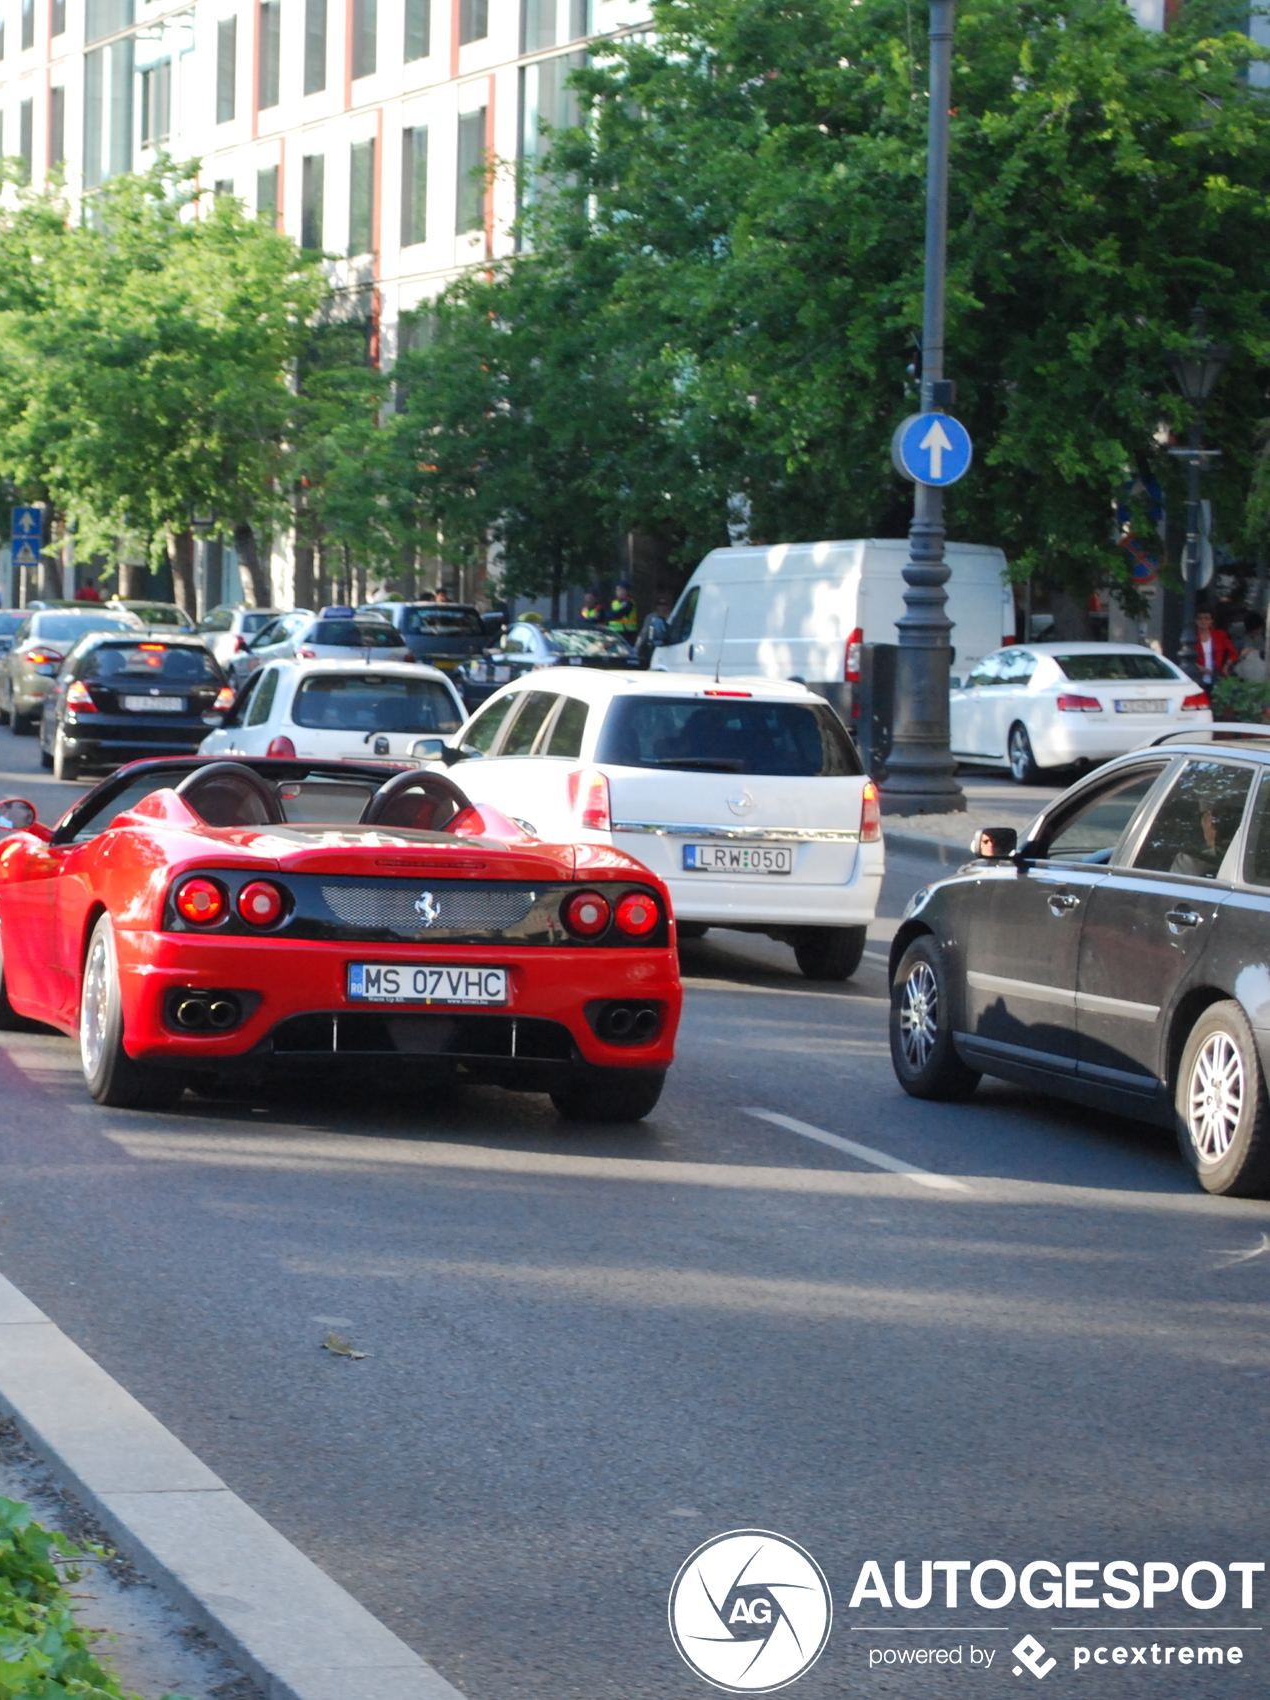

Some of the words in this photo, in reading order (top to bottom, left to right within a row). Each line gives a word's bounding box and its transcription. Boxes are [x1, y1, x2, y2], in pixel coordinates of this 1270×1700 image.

[351, 982, 363, 994] RO
[365, 968, 401, 995] MS
[412, 969, 501, 997] 07VHC
